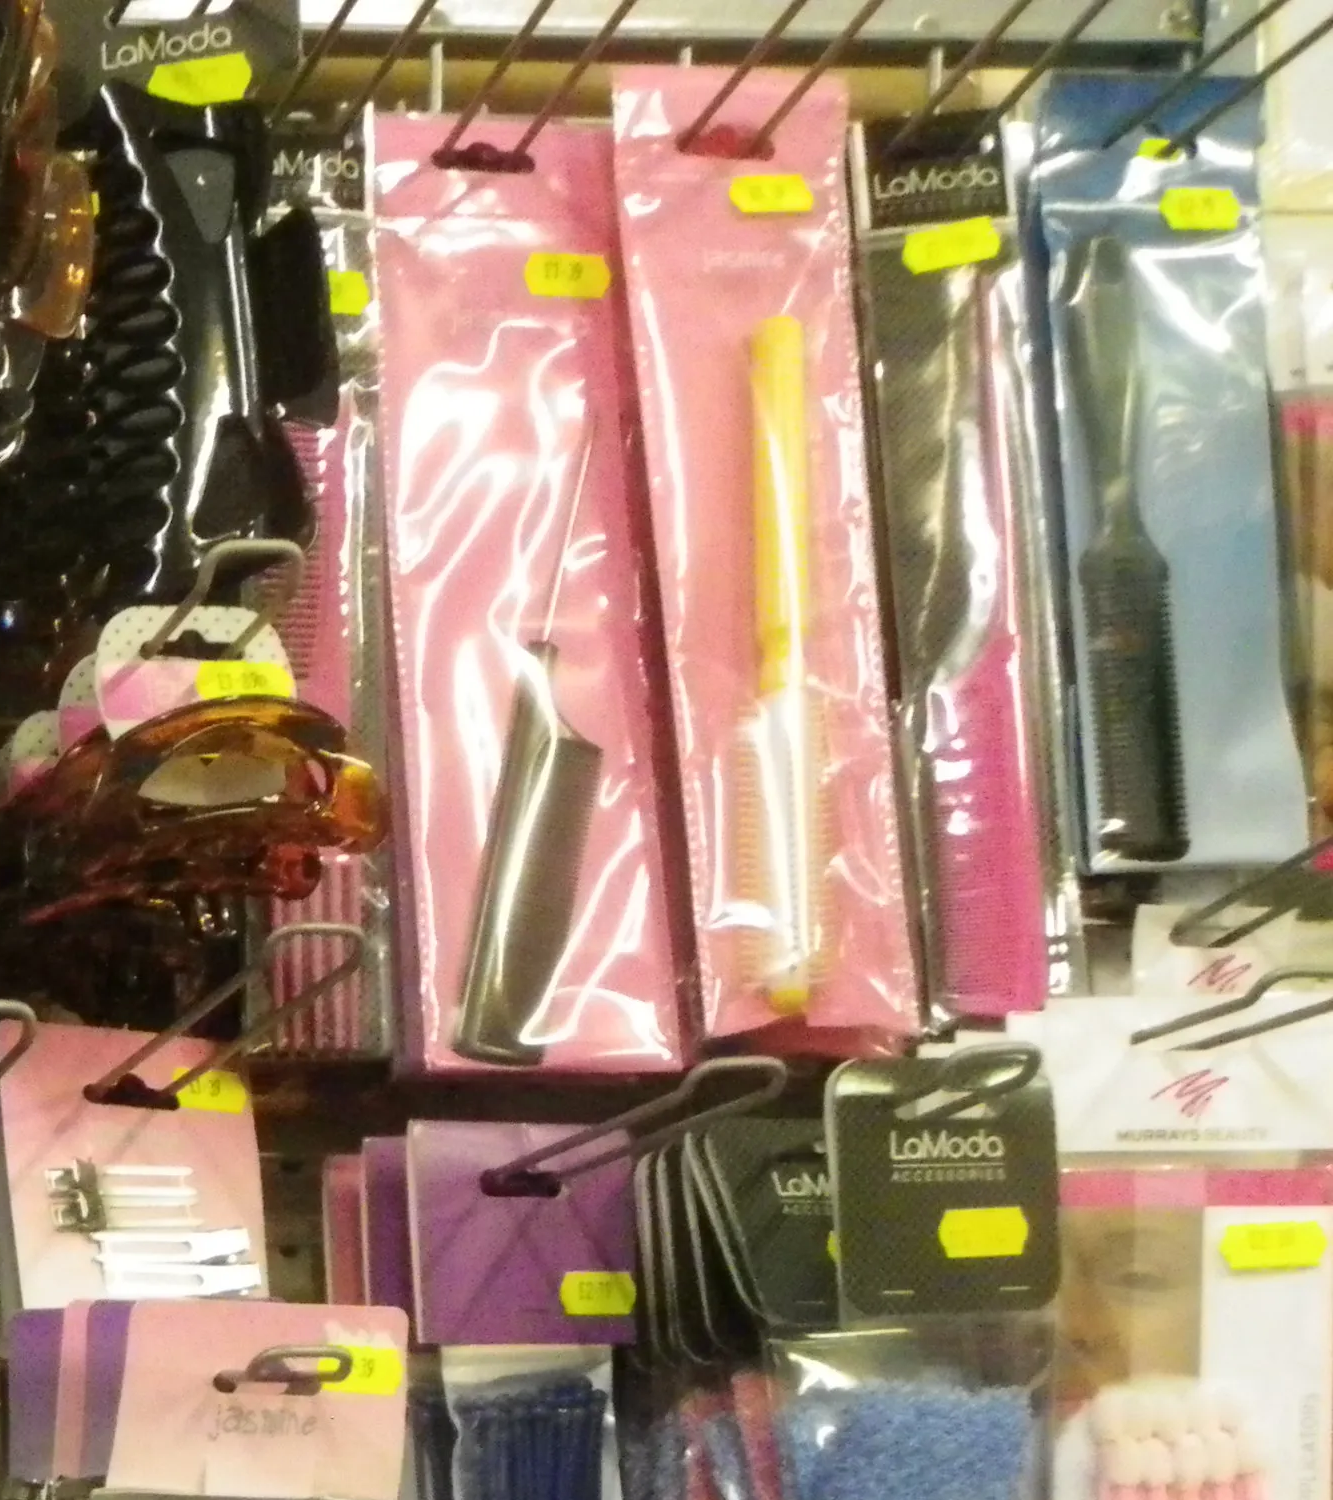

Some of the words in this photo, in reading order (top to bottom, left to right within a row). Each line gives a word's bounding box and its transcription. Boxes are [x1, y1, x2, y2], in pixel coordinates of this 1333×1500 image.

[101, 22, 233, 71] LaModa
[874, 163, 1001, 199] LaModa
[889, 1127, 1005, 1161] LaModa
[770, 1169, 832, 1198] LaM
[891, 1169, 1008, 1183] ACCESSORIES
[207, 1402, 318, 1442] jasmine
